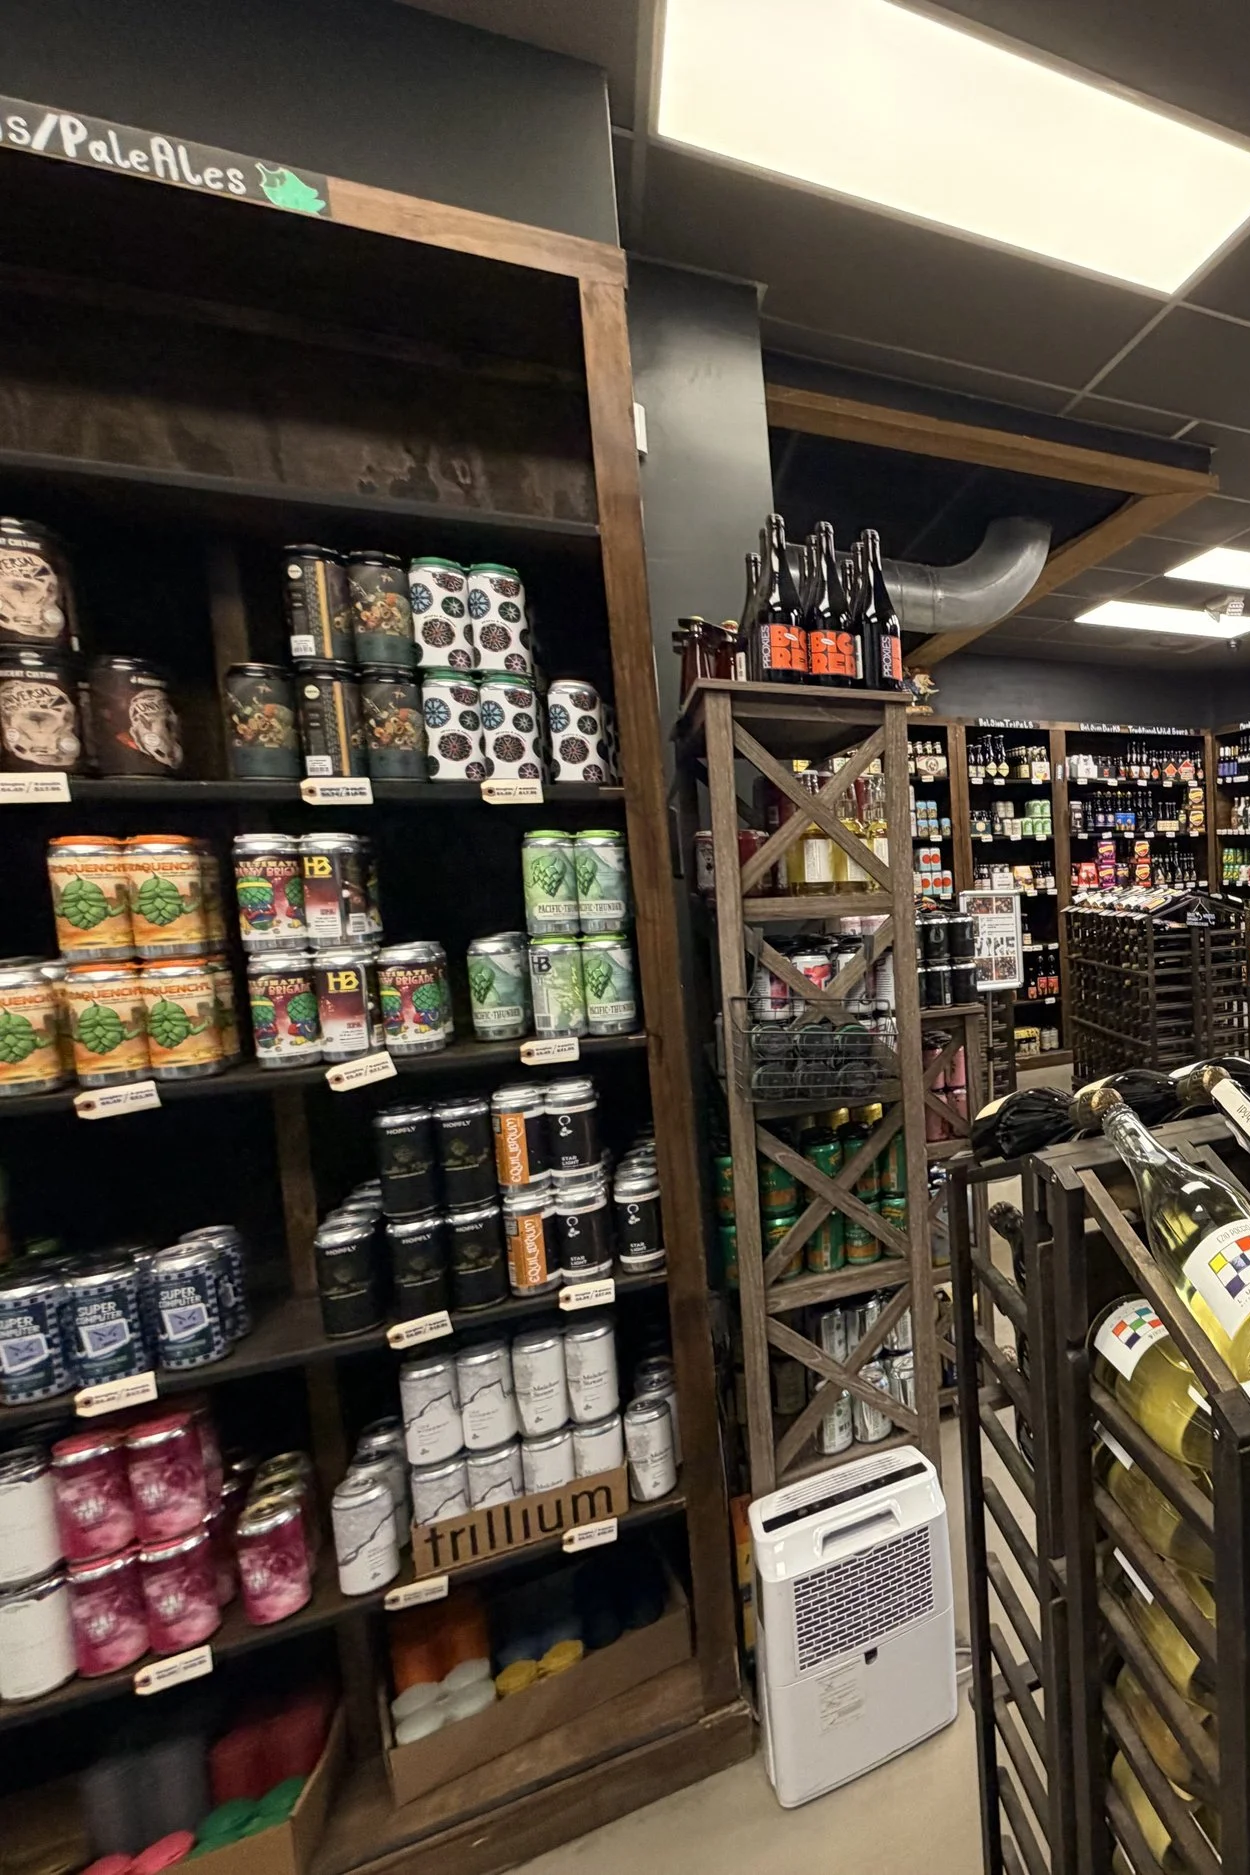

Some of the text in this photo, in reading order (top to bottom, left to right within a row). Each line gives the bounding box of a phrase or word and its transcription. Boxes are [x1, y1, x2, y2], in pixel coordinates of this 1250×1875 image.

[760, 625, 771, 669] PROXIES
[811, 632, 855, 654] BIG
[812, 653, 857, 676] RED
[881, 636, 892, 678] PROXIES
[538, 904, 562, 914] PACIFIC
[158, 1295, 202, 1309] COMPUTER
[160, 1287, 196, 1301] SUPER
[76, 1310, 123, 1325] COMPUTER
[77, 1302, 117, 1317] SUPER
[424, 1484, 613, 1567] trillium
